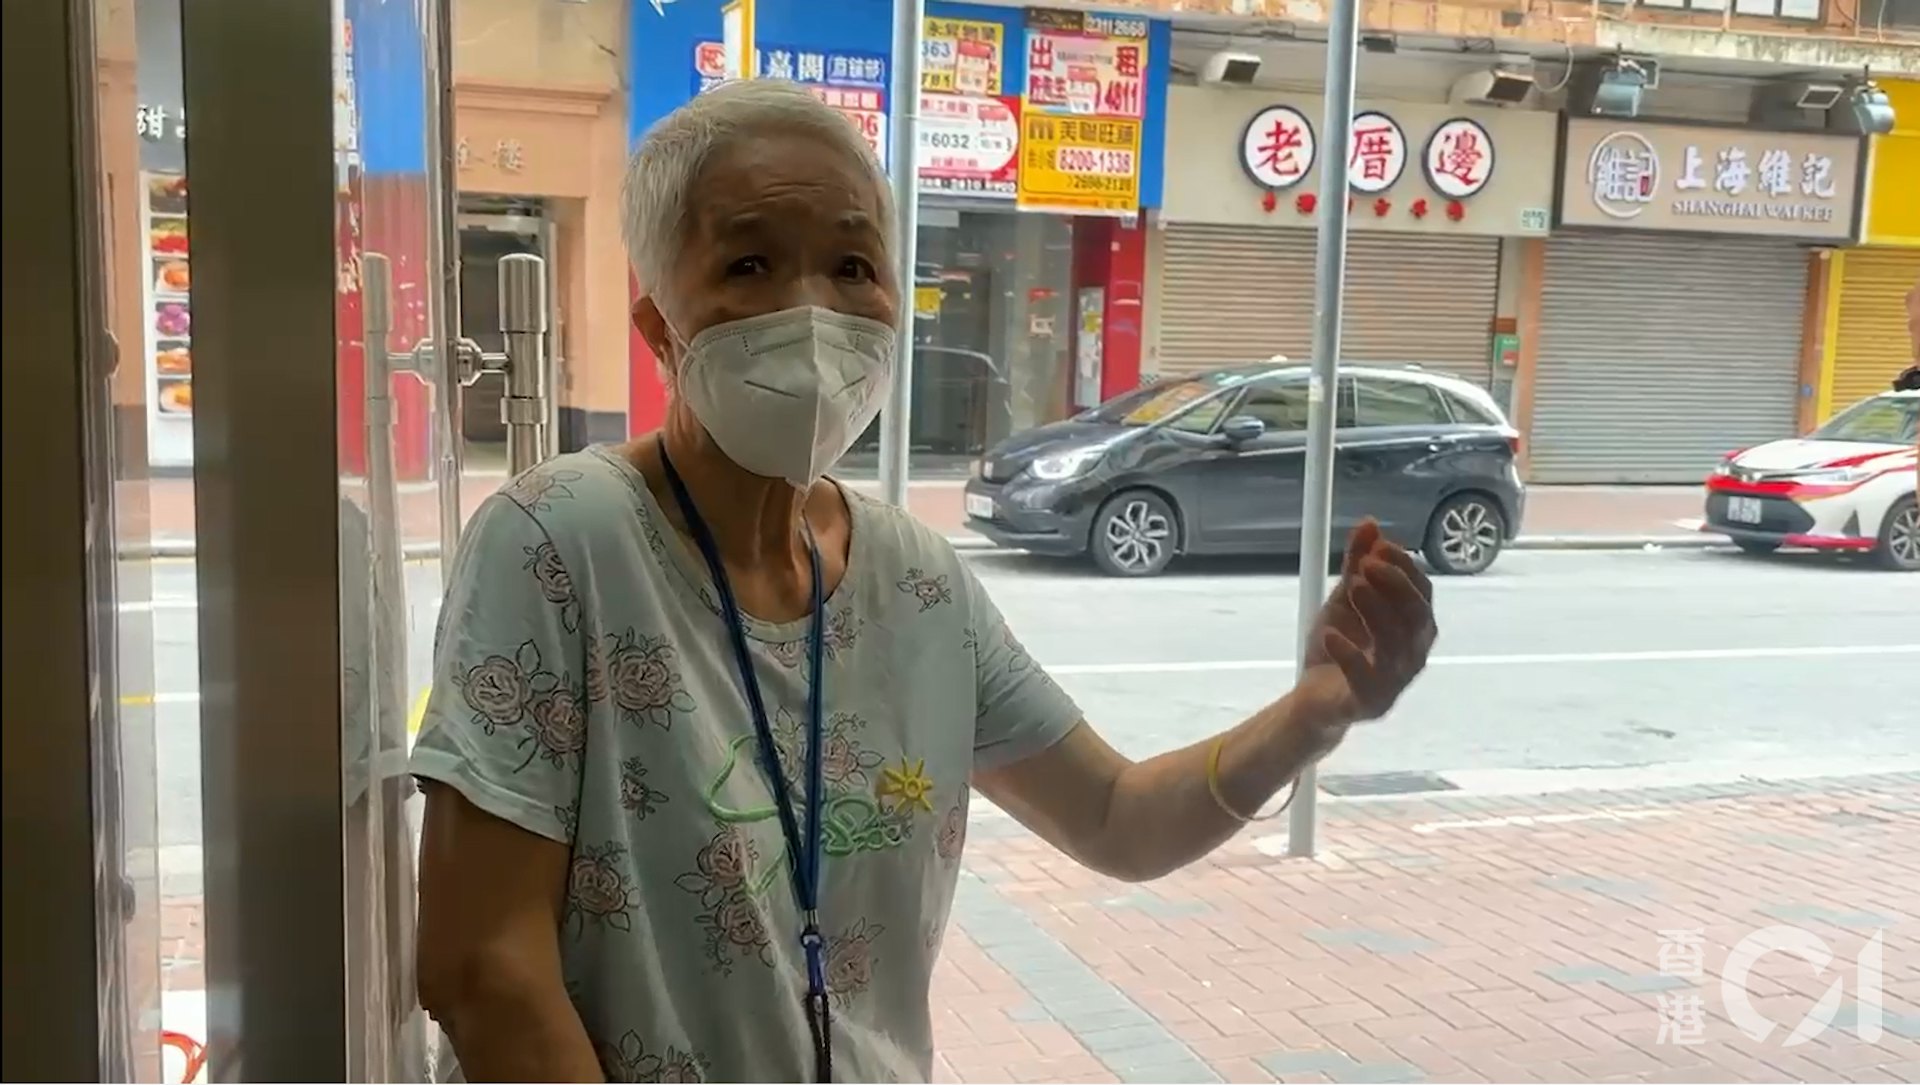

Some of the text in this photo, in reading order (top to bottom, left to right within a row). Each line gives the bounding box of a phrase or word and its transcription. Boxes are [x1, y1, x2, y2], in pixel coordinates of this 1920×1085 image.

[1029, 37, 1053, 71] 出
[136, 104, 185, 139] 甜
[1256, 120, 1483, 188] 老厝邊
[1675, 145, 1837, 199] 上海維記
[1671, 199, 1762, 219] SHANGHAI
